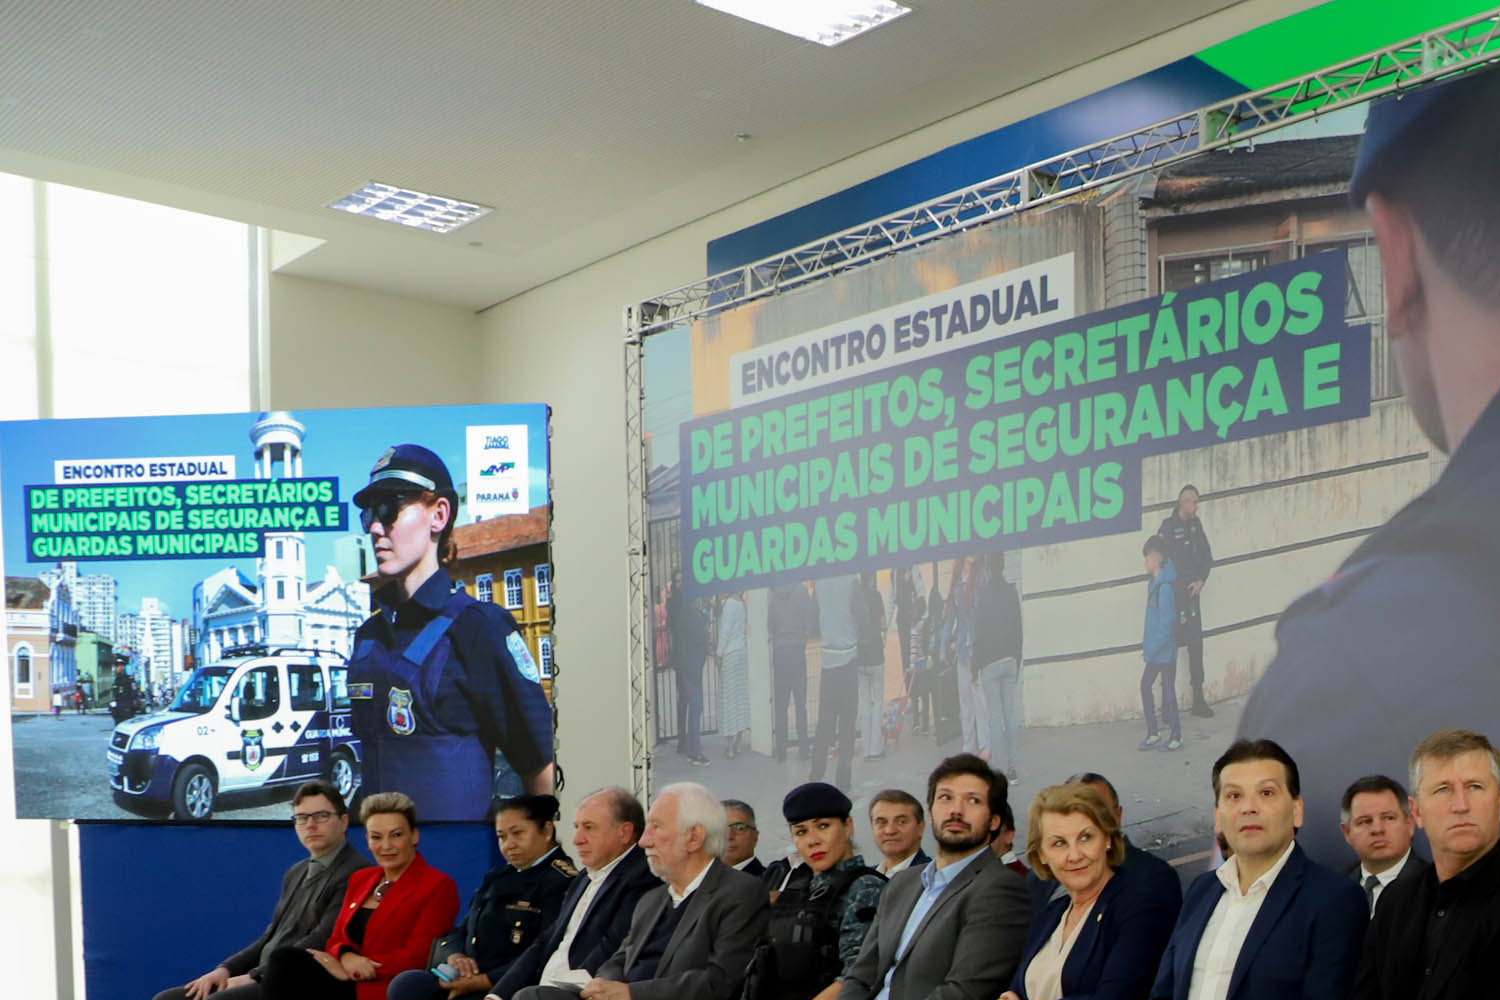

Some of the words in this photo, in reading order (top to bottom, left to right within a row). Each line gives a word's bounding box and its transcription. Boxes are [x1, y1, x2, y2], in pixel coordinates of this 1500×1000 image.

[691, 423, 733, 473] DE
[741, 368, 956, 462] PREFEITOS,
[965, 271, 1324, 409] SECRETÁRIOS
[740, 325, 886, 396] ENCONTRO
[893, 274, 1060, 354] ESTADUAL
[62, 464, 145, 480] ENCONTRO
[149, 461, 228, 477] ESTADUAL
[692, 444, 894, 529] MUNICIPAIS
[904, 428, 958, 487] DE
[968, 356, 1289, 473] SEGURANÇA
[1303, 343, 1341, 410] E
[30, 488, 60, 509] DE
[62, 485, 182, 509] PREFEITOS,
[185, 479, 333, 506] SECRETÁRIOS
[31, 511, 150, 533] MUNICIPAIS
[154, 510, 184, 530] DE
[188, 506, 321, 532] SEGURANÇA
[325, 506, 340, 526] E
[692, 511, 859, 585] GUARDAS
[867, 461, 1124, 556] MUNICIPAIS
[32, 535, 133, 558] GUARDAS
[137, 532, 259, 556] MUNICIPAIS
